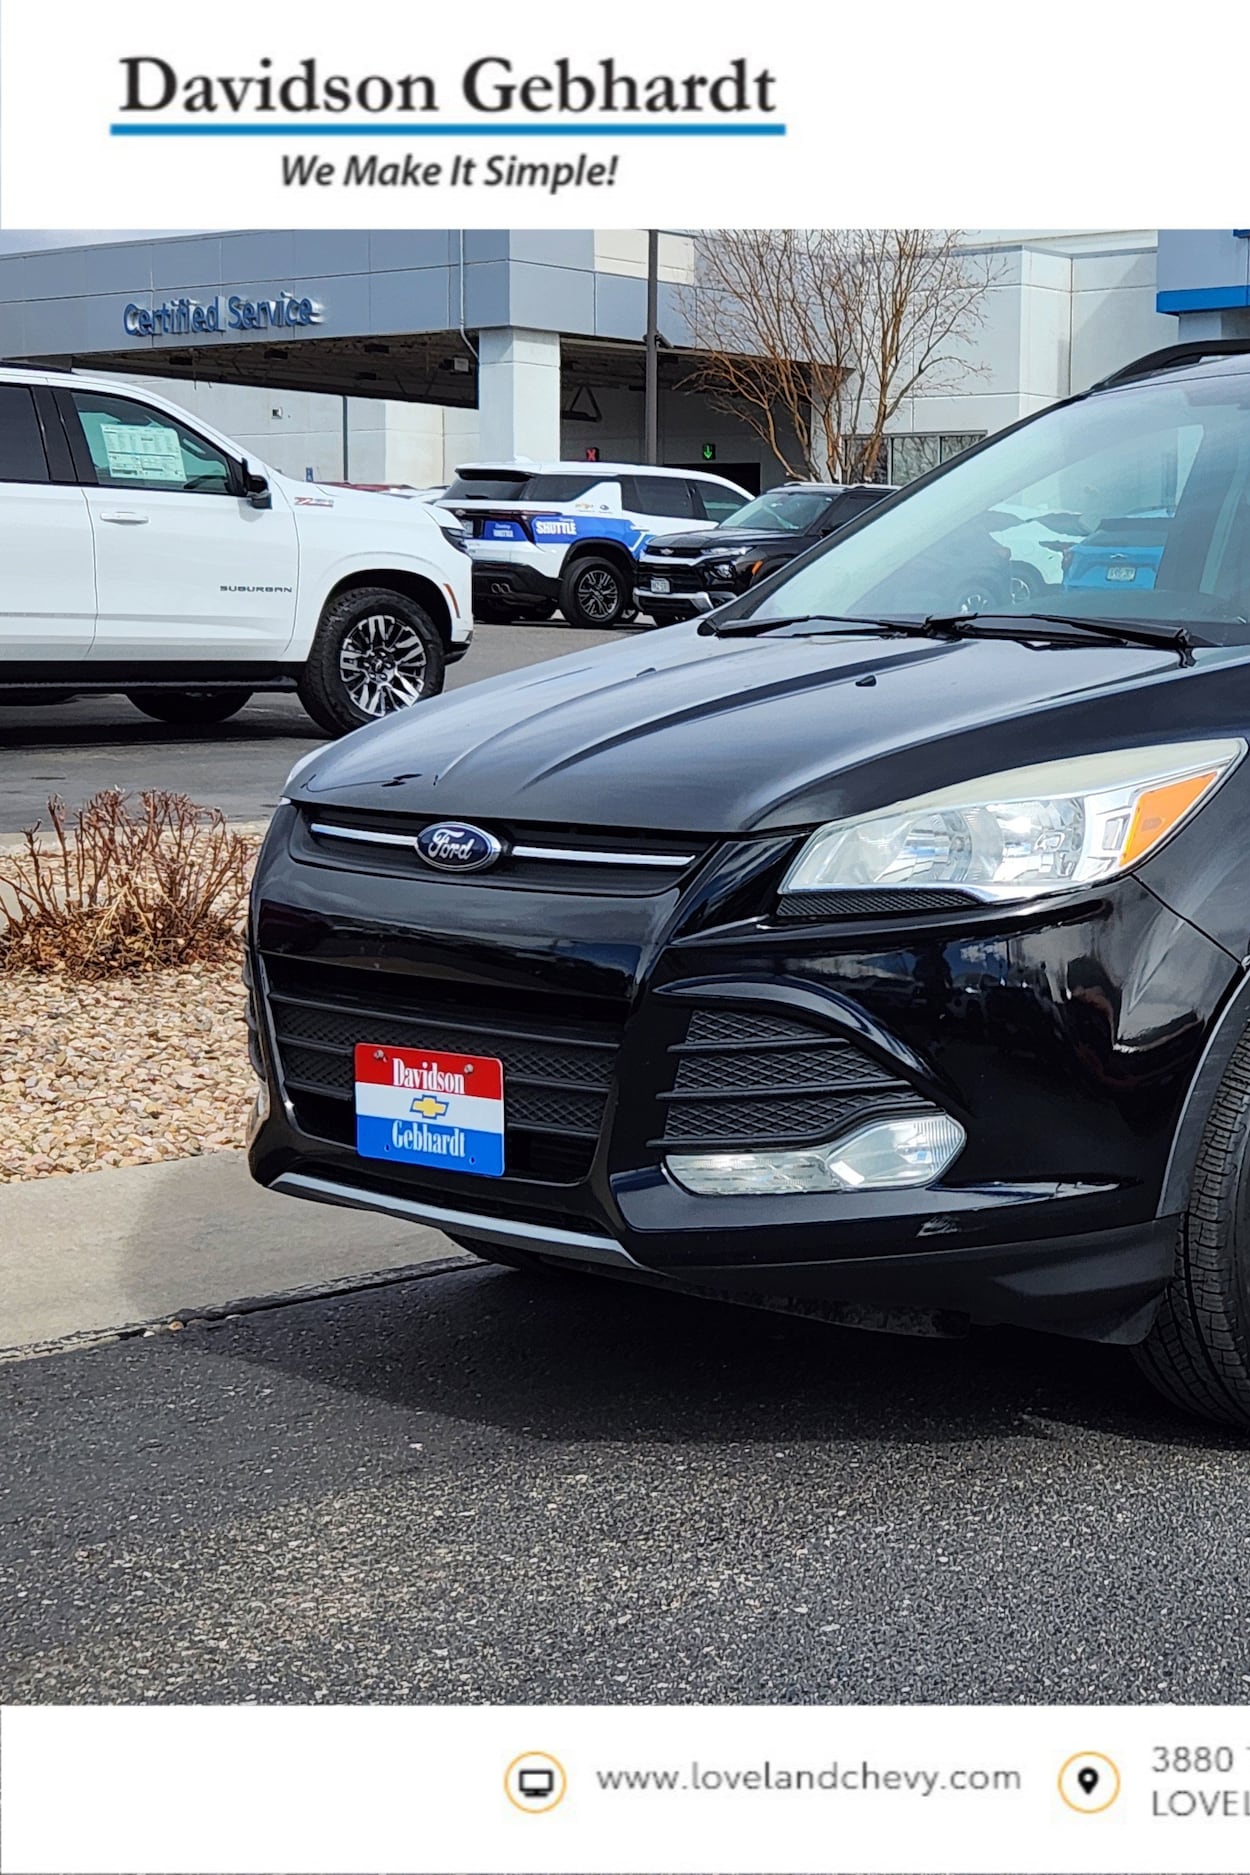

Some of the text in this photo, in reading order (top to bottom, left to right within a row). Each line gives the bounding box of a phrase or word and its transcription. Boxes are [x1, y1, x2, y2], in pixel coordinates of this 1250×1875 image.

[124, 290, 322, 336] Certified Service
[535, 520, 577, 536] SHUTTLE
[219, 585, 293, 594] SUBURBAN
[427, 828, 474, 861] Ford
[391, 1057, 465, 1095] Davidson
[391, 1119, 466, 1158] Gebhardt
